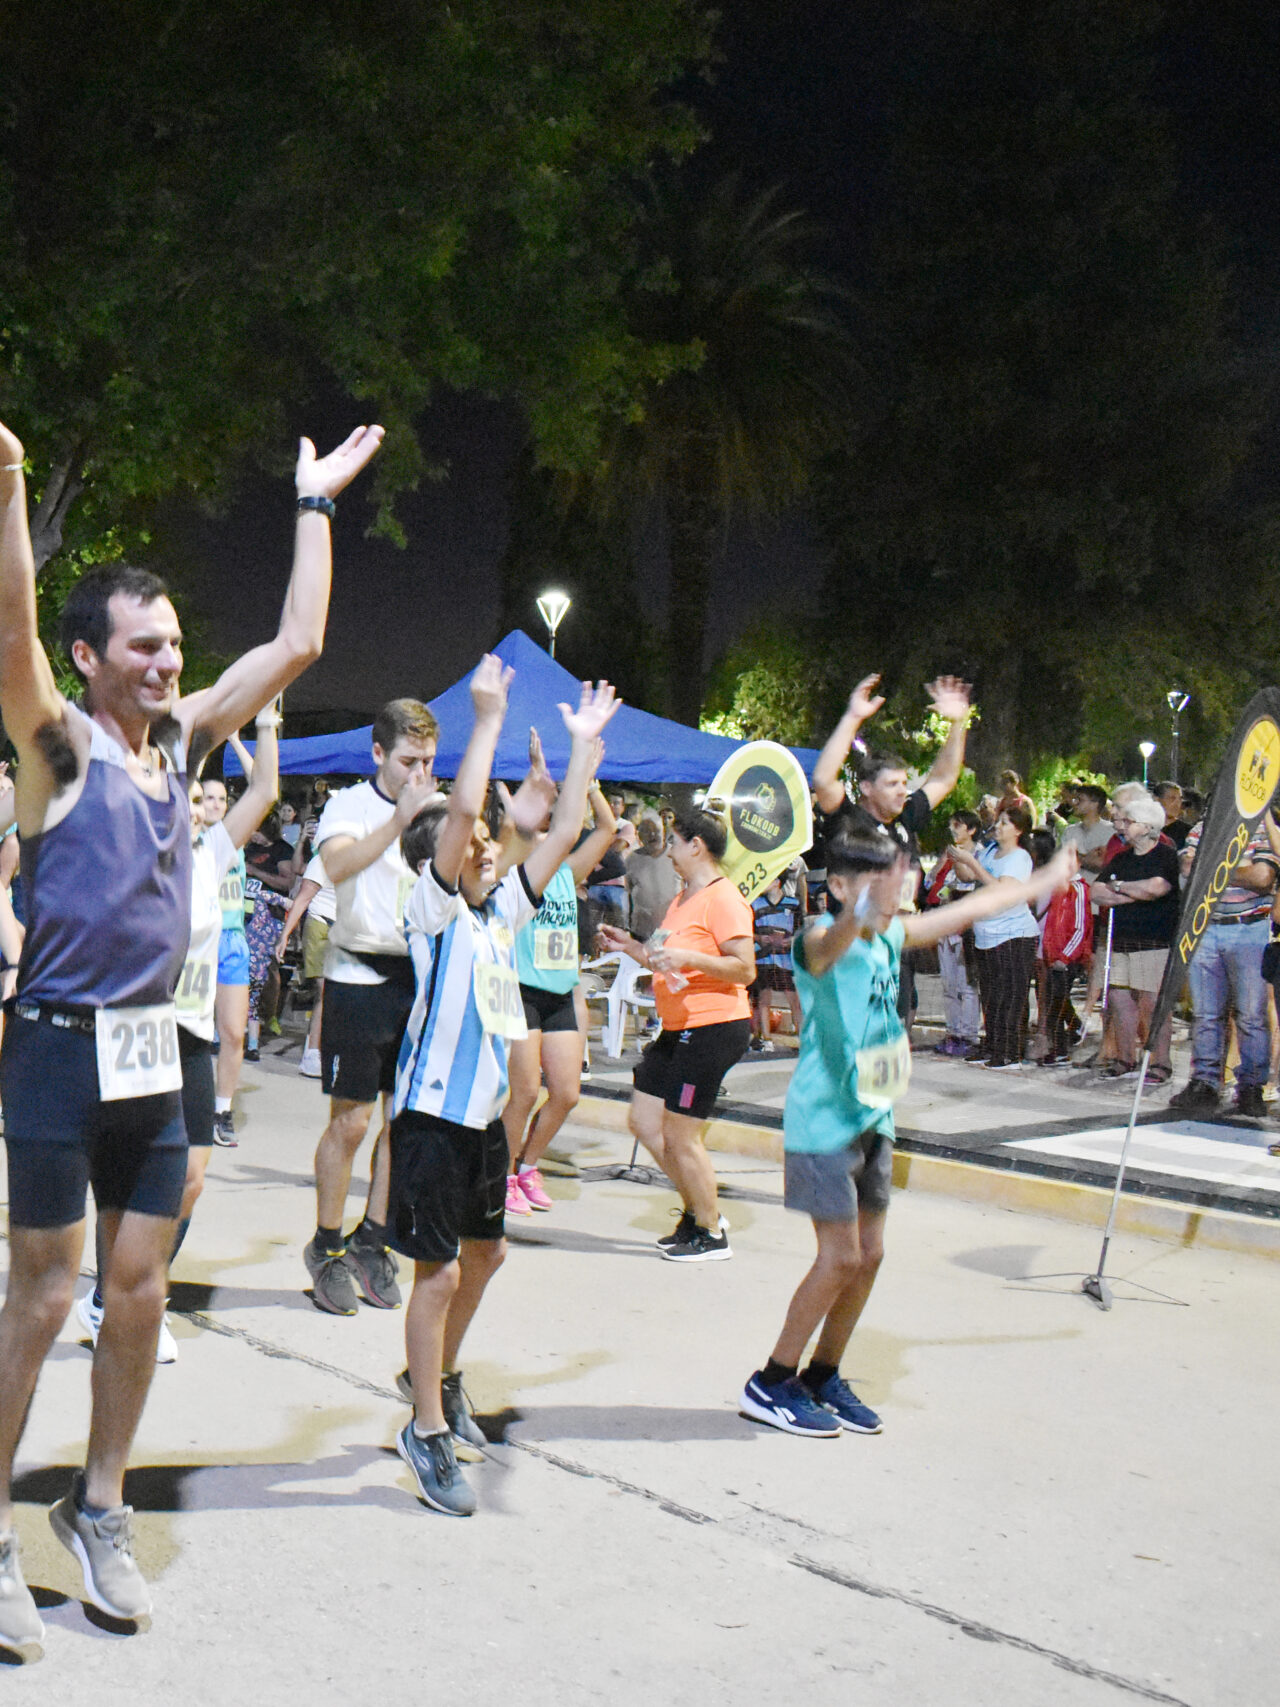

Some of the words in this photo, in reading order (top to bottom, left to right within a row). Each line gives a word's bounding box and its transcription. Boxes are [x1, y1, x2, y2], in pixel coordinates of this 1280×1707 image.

[739, 808, 780, 837] FLOKOOB
[1179, 822, 1249, 964] FLOKOOB
[547, 931, 574, 961] 62
[111, 1017, 177, 1071] 238
